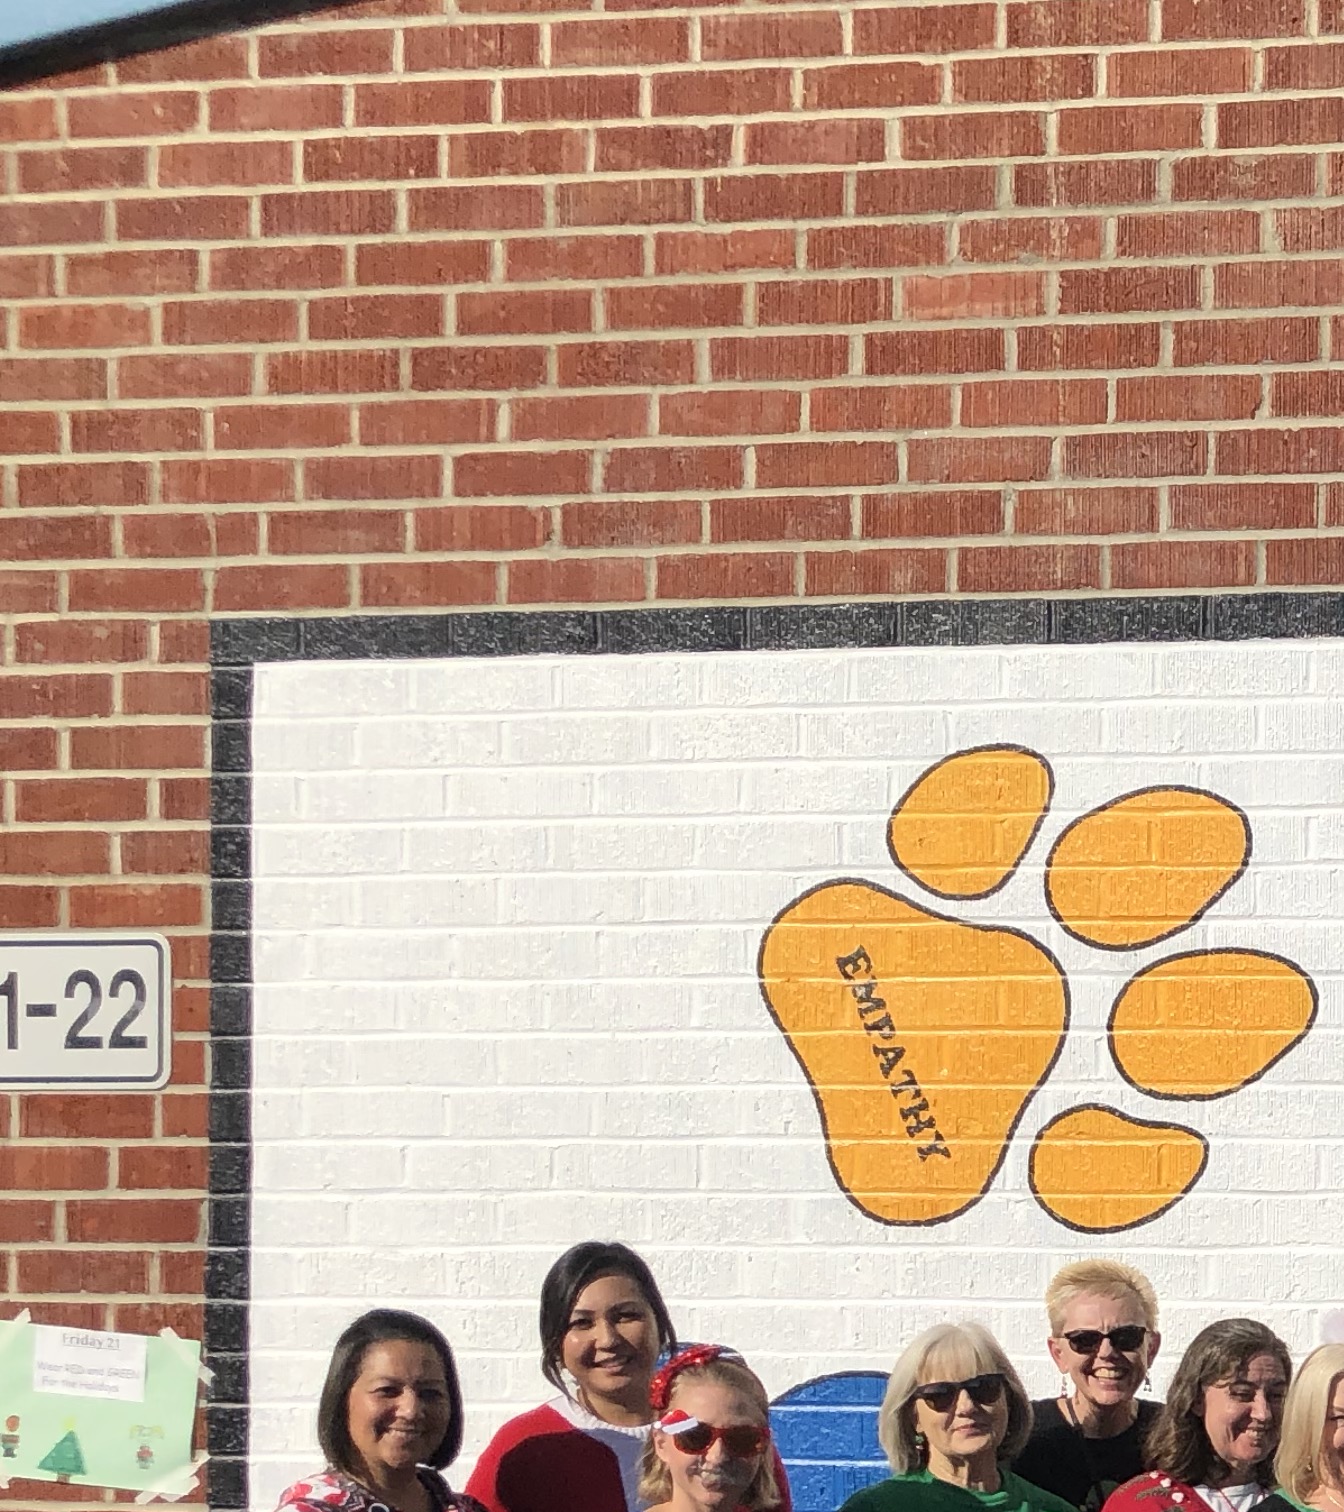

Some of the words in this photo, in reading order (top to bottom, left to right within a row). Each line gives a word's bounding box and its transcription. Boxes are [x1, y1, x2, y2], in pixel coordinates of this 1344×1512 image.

[836, 944, 952, 1162] EMPATHY
[62, 1333, 104, 1349] Friday
[107, 1338, 120, 1349] 21
